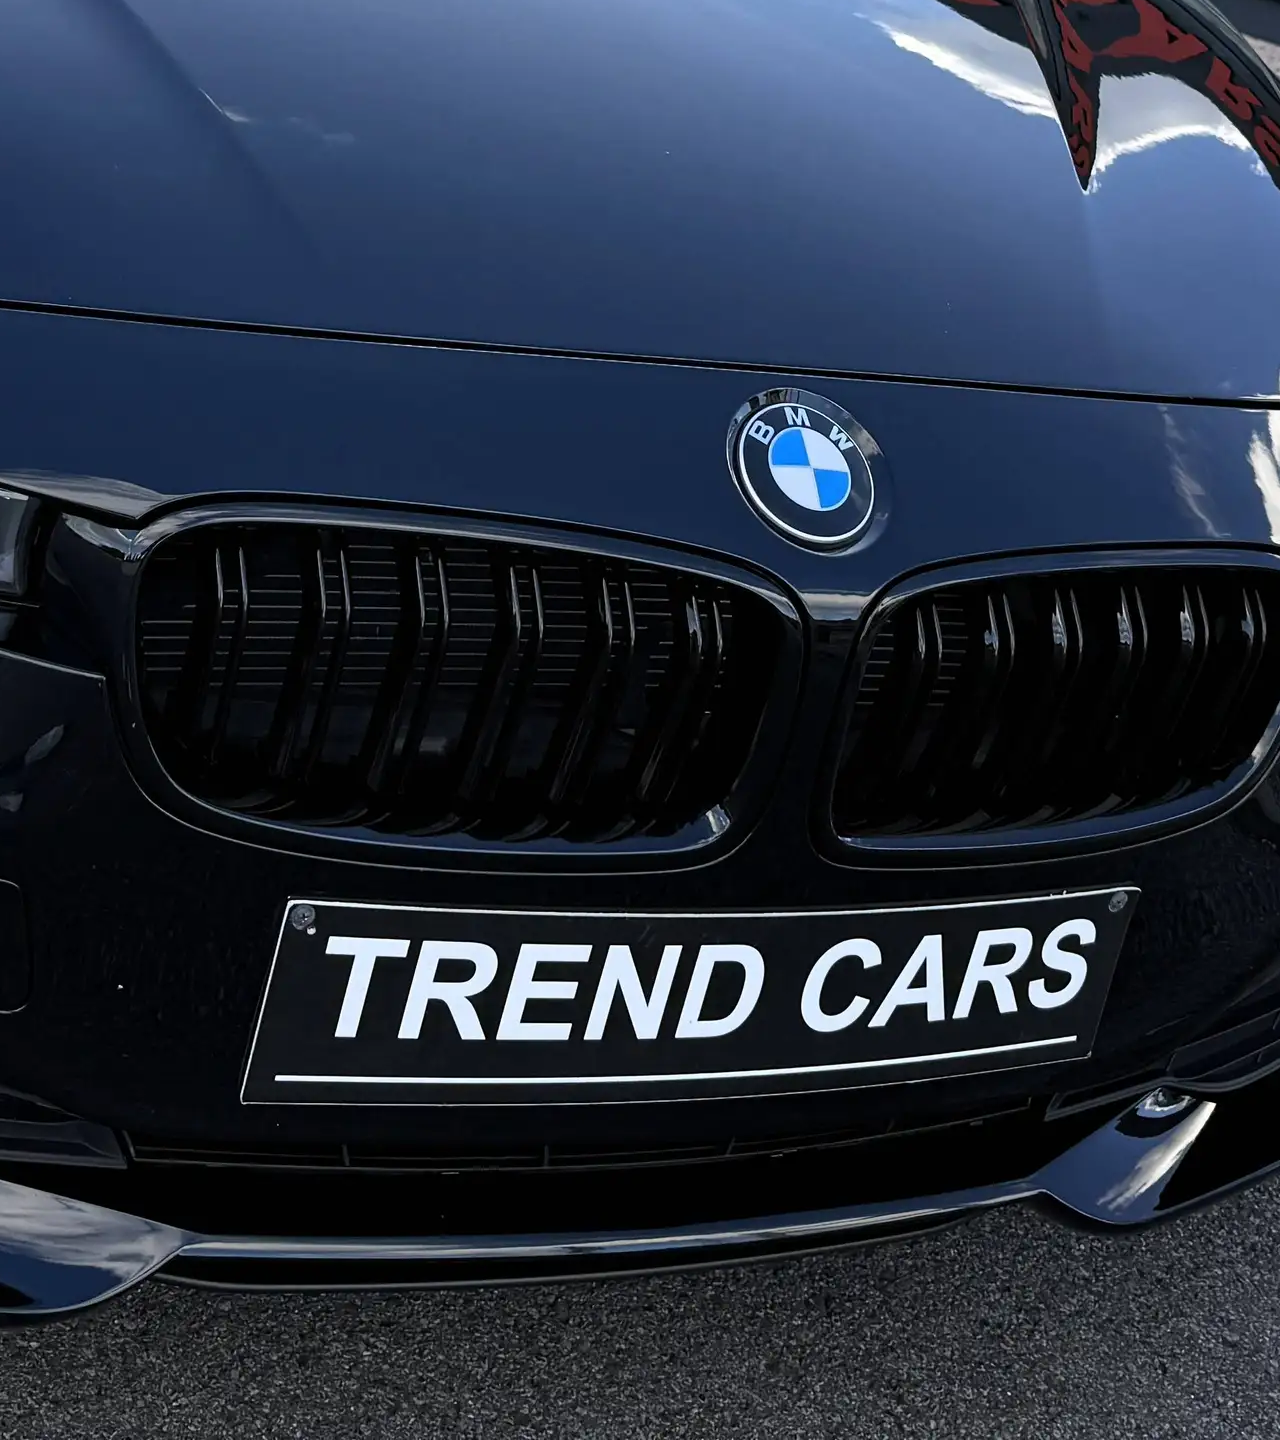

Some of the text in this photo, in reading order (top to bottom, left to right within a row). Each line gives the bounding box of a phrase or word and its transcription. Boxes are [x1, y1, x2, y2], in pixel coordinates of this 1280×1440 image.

[748, 406, 853, 451] BMW
[323, 917, 1096, 1041] TREND CARS
